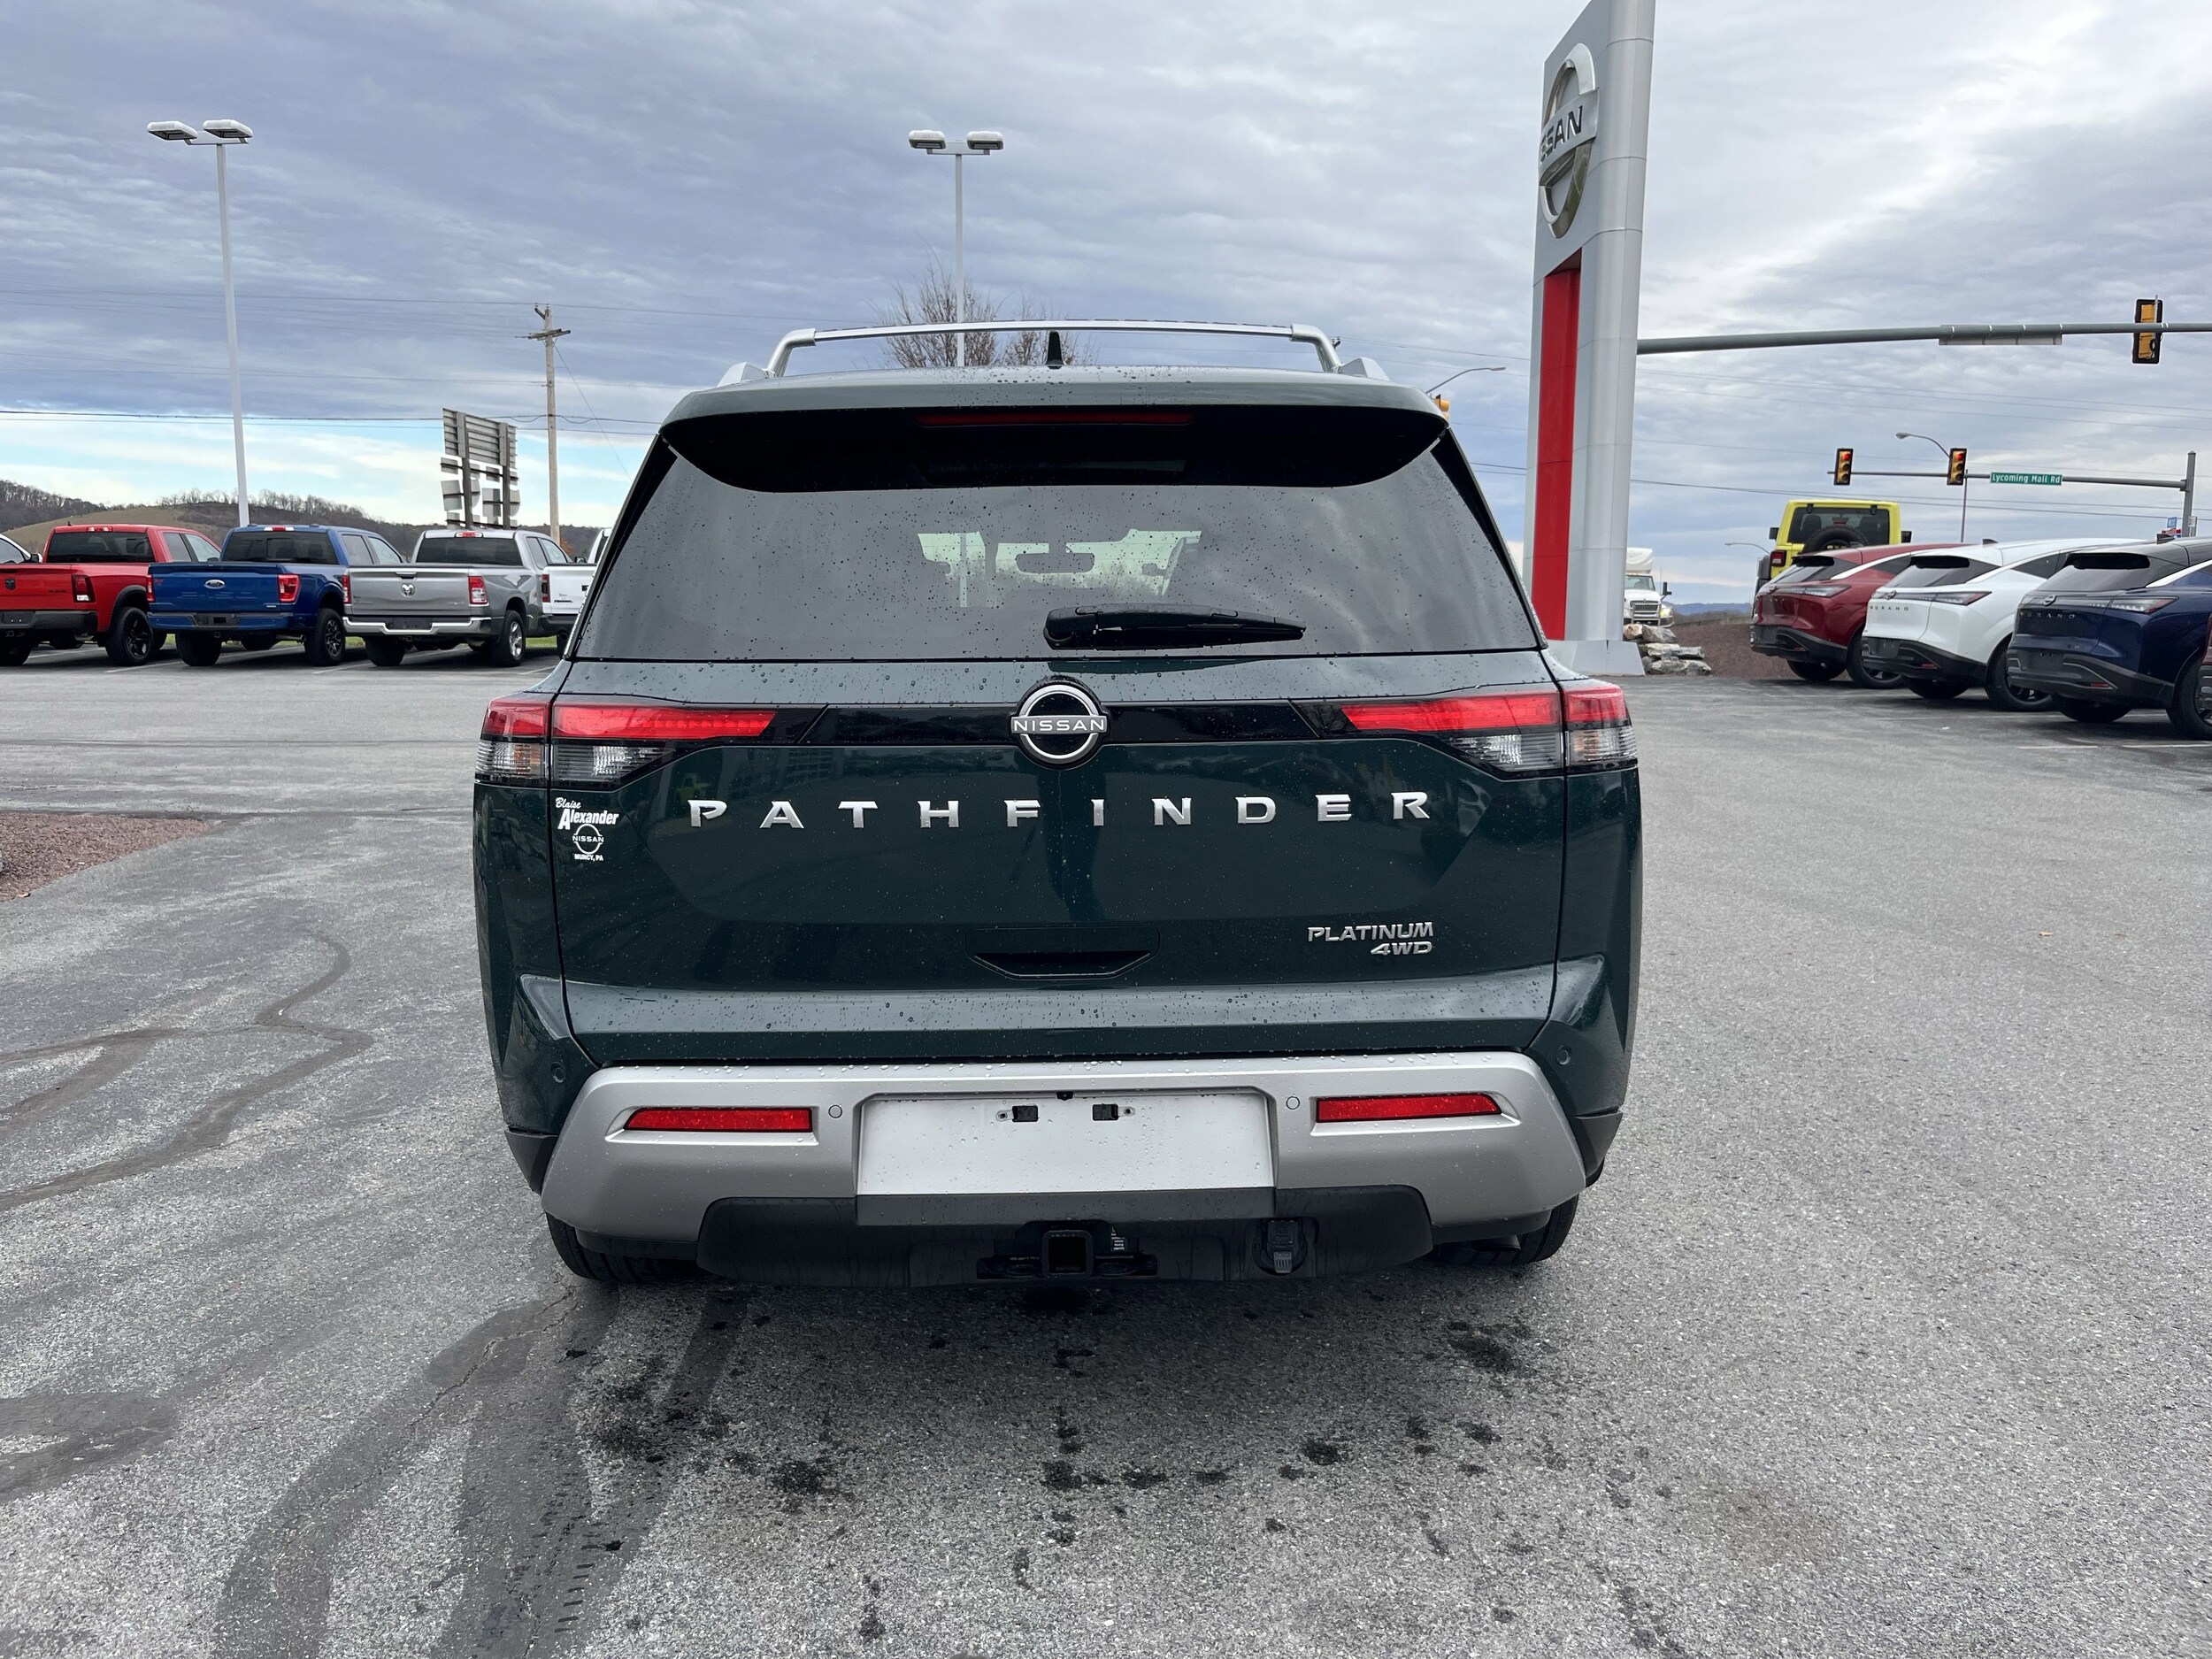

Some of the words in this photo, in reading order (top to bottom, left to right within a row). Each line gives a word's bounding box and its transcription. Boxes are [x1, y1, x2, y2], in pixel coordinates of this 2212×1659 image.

[1992, 472, 2029, 484] Lycoming
[2031, 474, 2047, 483] Mall
[1014, 718, 1104, 732] NISSAN
[555, 796, 582, 810] Blaise
[688, 791, 1430, 829] PATHFINDER
[557, 809, 619, 830] Alexander
[1307, 921, 1434, 942] PLATINUM
[1371, 941, 1433, 956] 4WD
